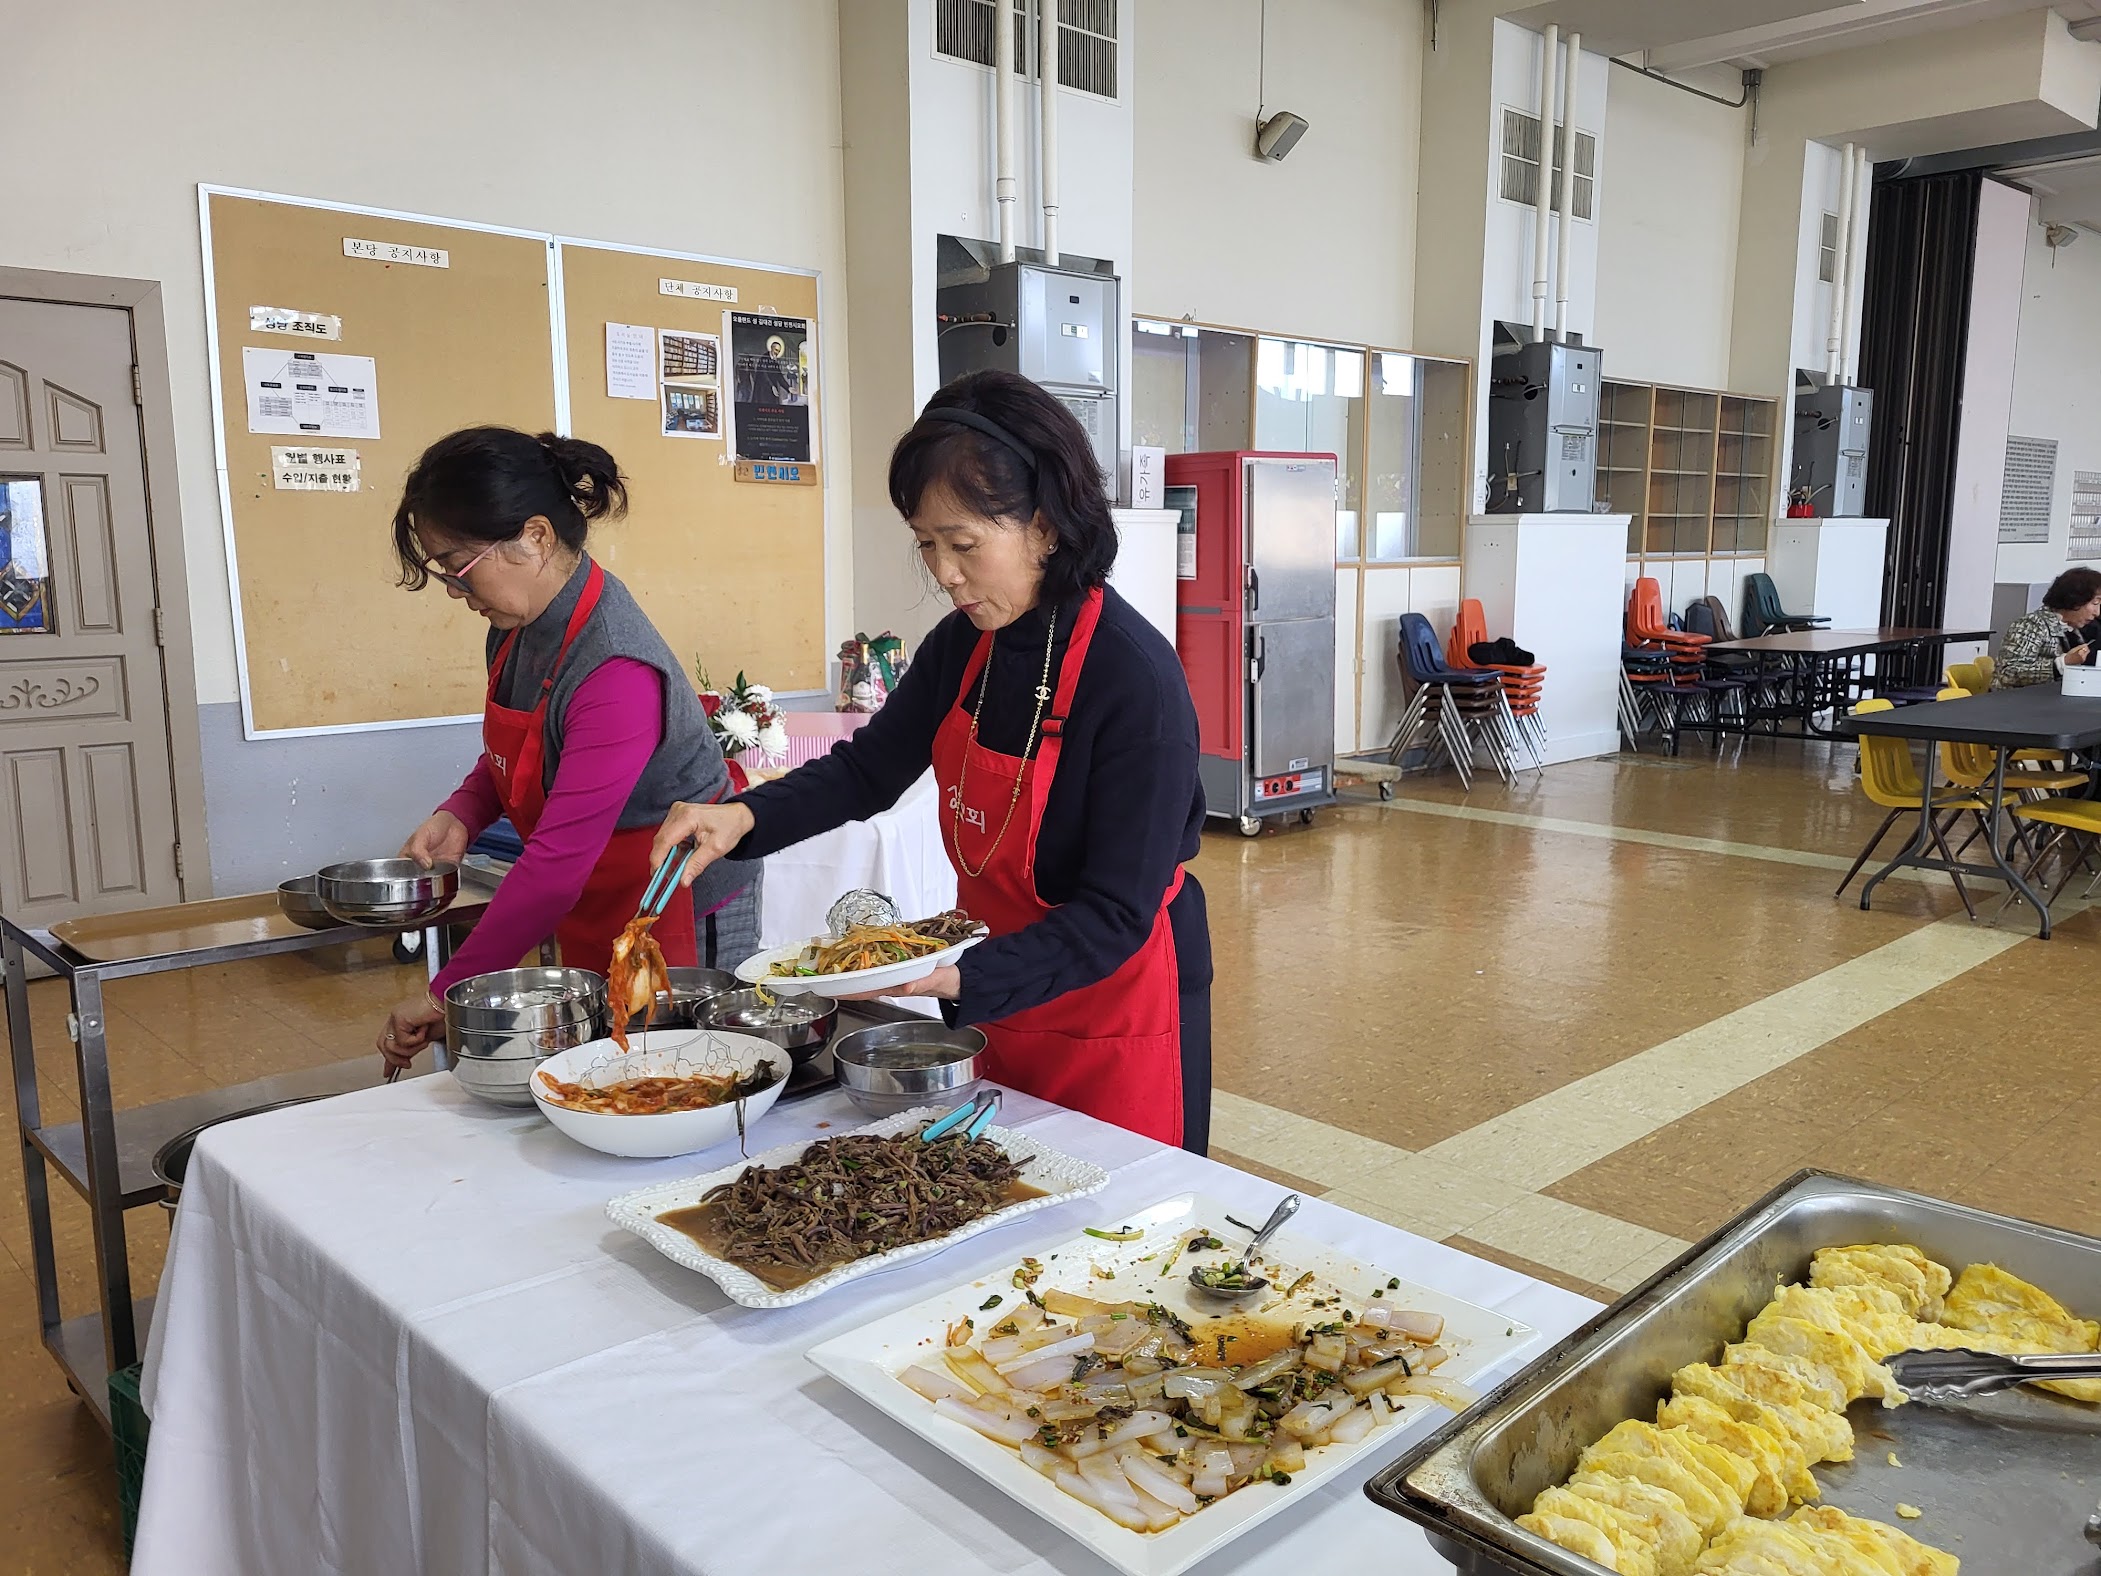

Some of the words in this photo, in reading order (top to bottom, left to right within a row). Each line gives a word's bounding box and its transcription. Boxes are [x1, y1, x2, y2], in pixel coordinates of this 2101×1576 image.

[351, 241, 378, 257] 본당
[387, 246, 442, 265] 공지사항
[691, 285, 734, 301] 공지사항
[292, 321, 328, 335] 조직도
[284, 452, 308, 464] 월별
[312, 453, 346, 465] 행사표
[282, 472, 328, 484] 수입/지출
[331, 473, 352, 484] 현황
[1139, 453, 1151, 502] 유가족
